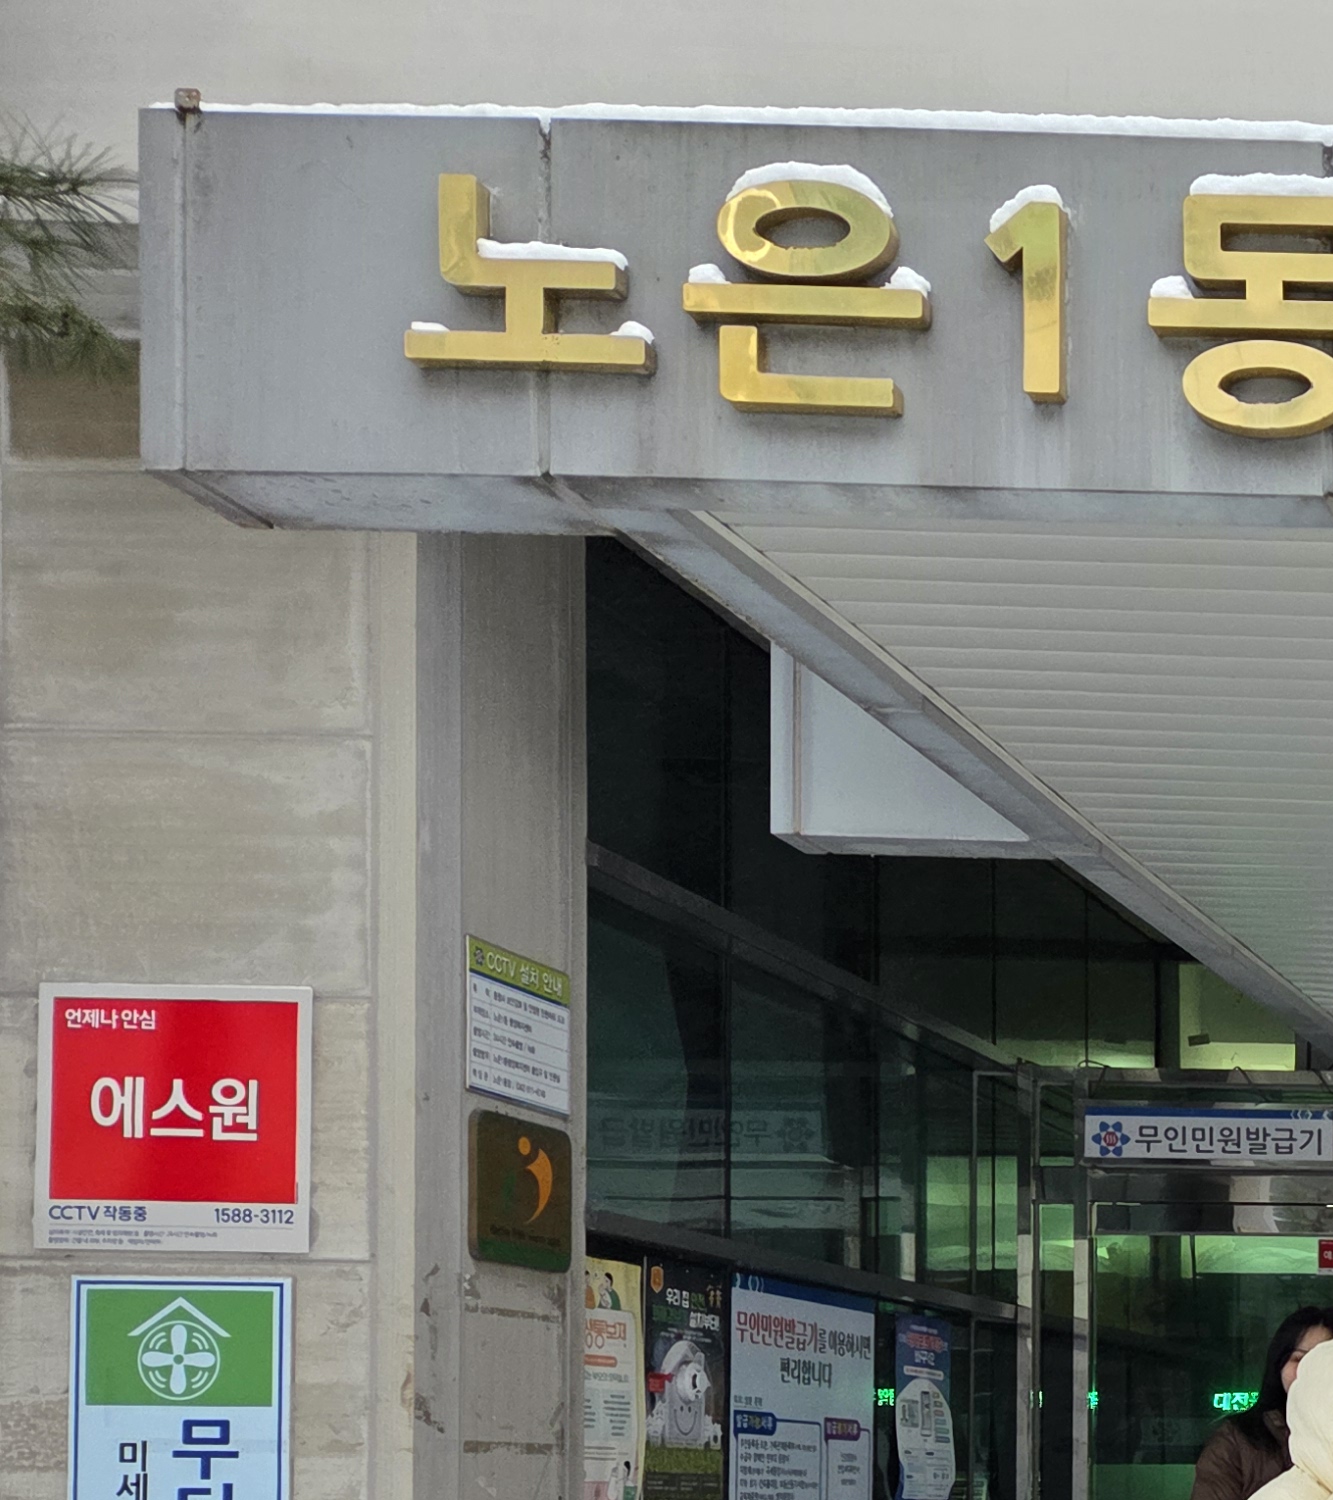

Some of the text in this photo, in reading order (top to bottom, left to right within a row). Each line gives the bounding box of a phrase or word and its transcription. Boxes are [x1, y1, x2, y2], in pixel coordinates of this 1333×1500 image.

[487, 952, 563, 998] CCTV 설치 안내
[65, 1008, 157, 1030] 언제나 안심
[90, 1076, 258, 1142] 에스원
[1135, 1125, 1323, 1156] 무인민원발급기
[48, 1205, 148, 1222] CCTV 작동중
[214, 1207, 296, 1226] 1588-3112
[735, 1310, 827, 1354] 무인민원발급기를
[828, 1329, 872, 1360] 이용하시면
[779, 1356, 833, 1389] 편리합니다
